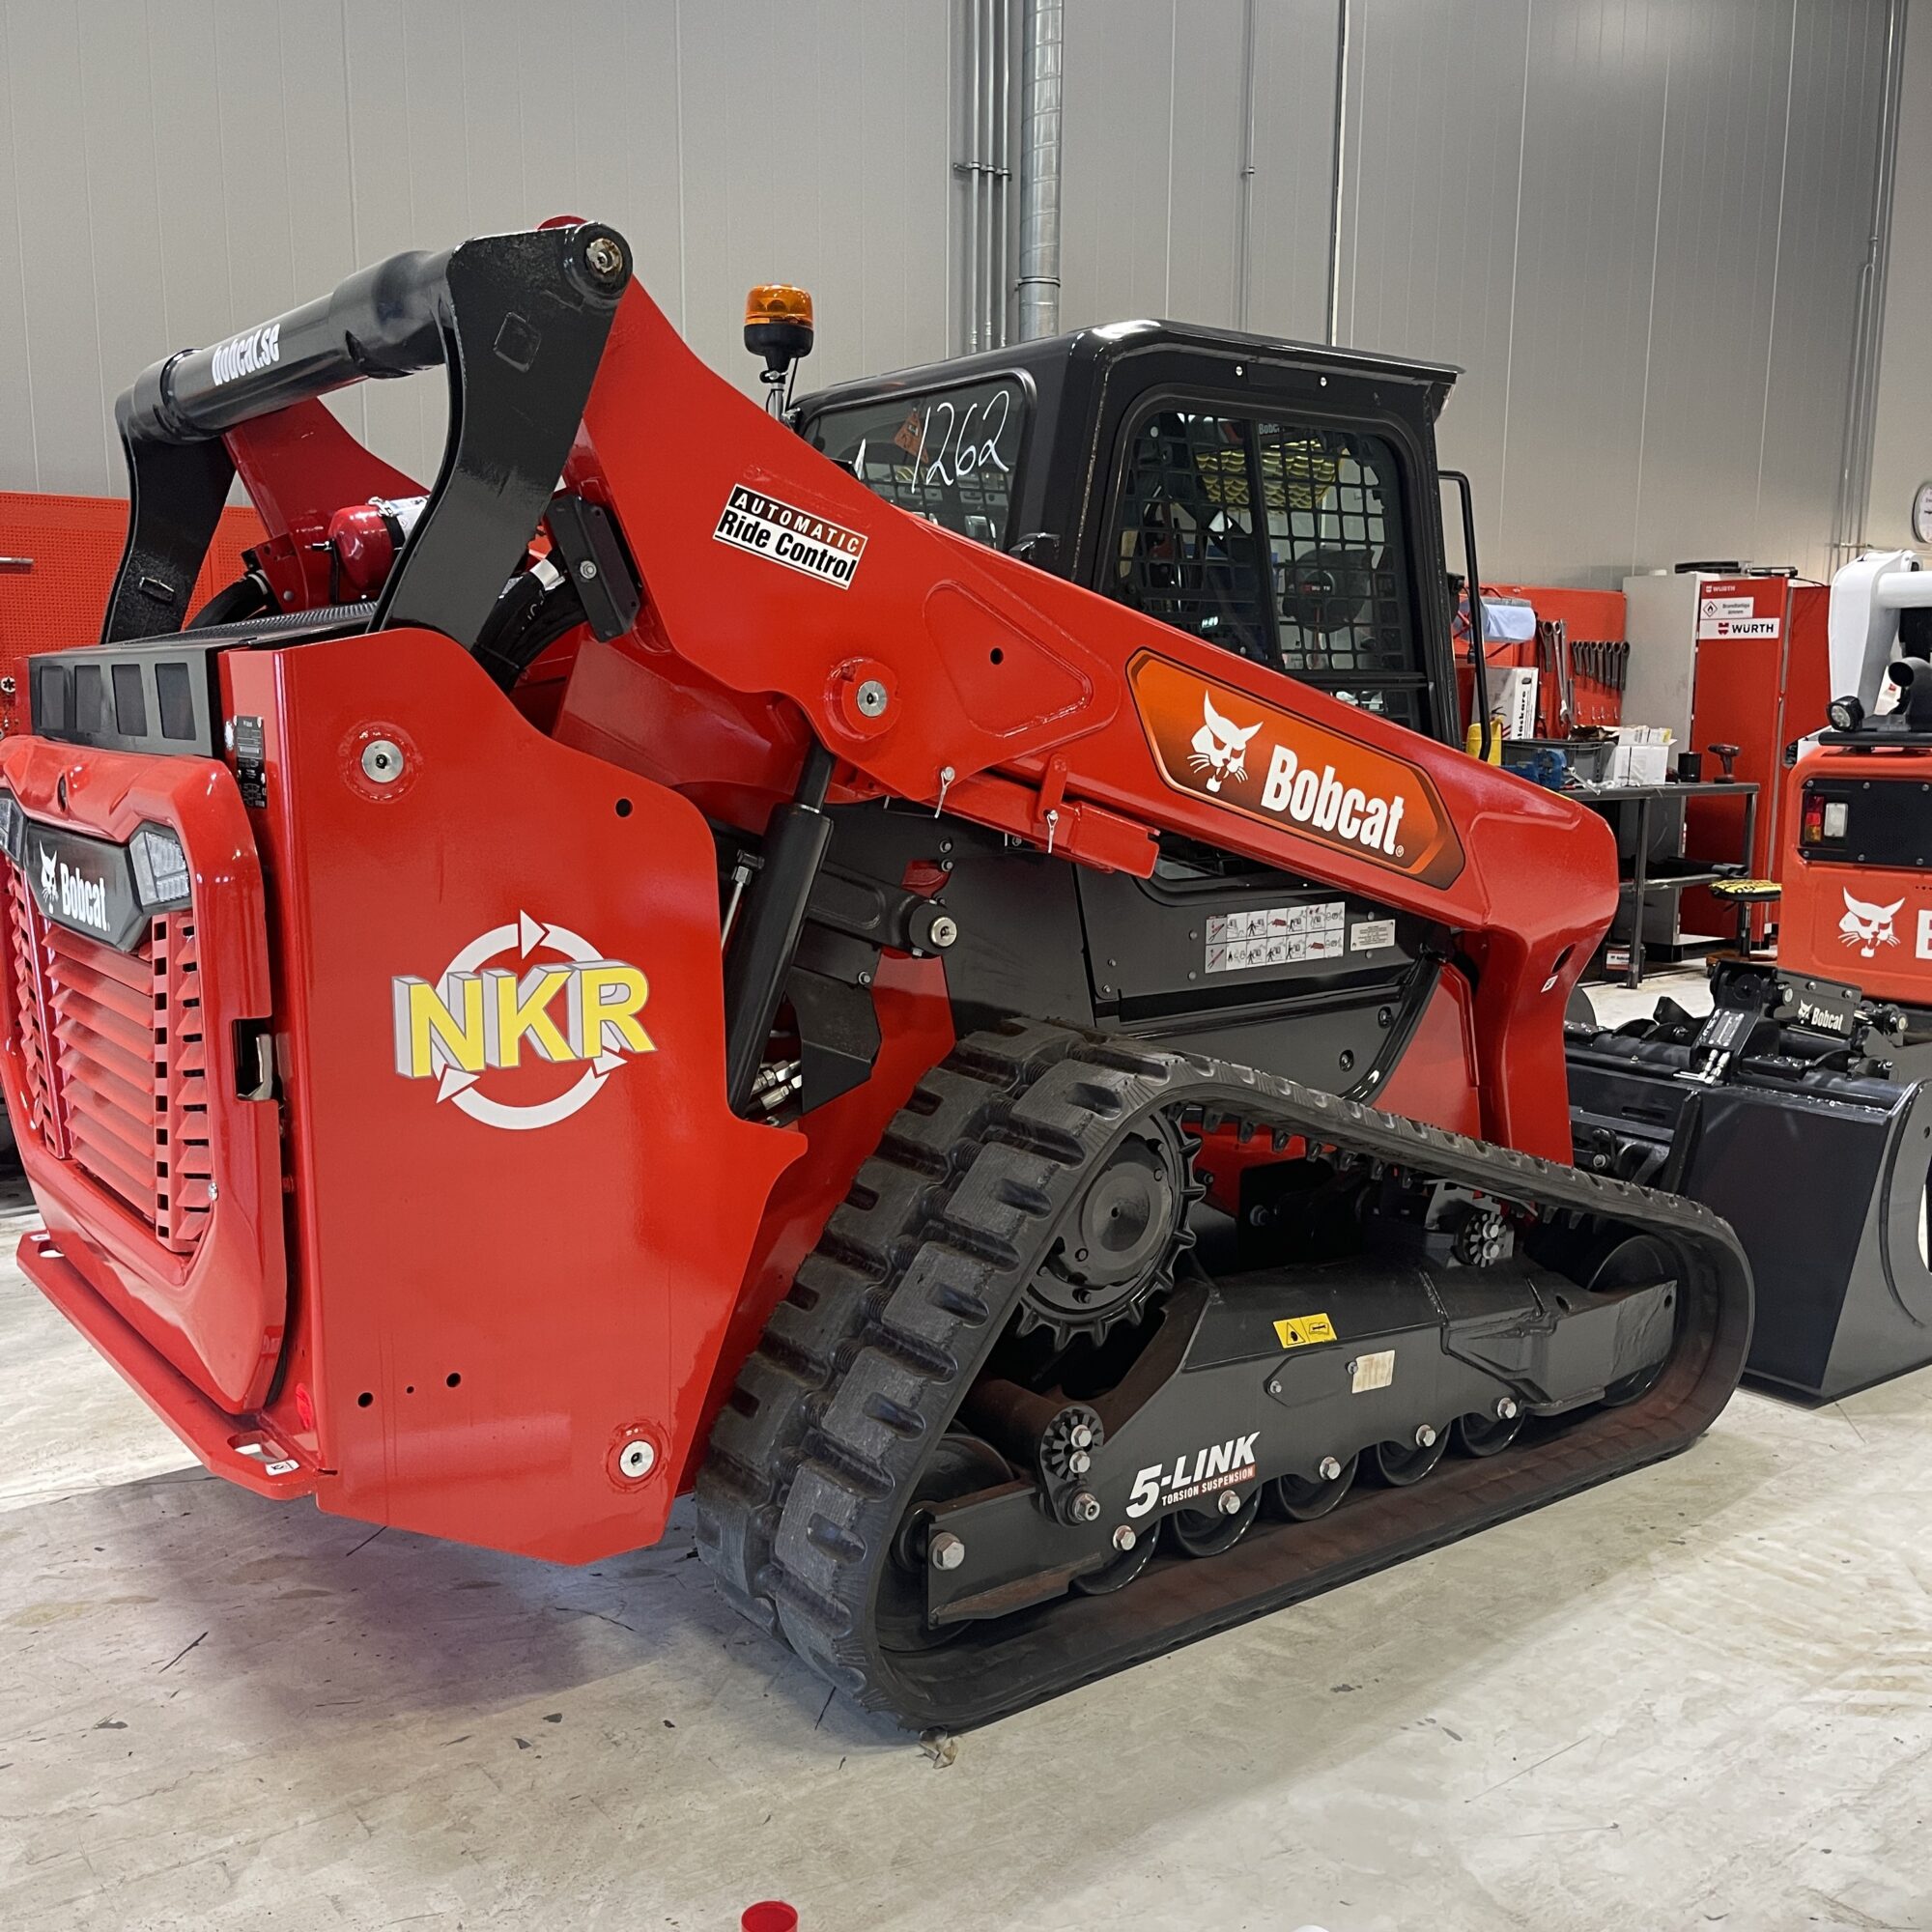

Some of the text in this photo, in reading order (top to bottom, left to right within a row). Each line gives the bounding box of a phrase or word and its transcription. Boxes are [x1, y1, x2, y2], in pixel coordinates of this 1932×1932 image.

[911, 389, 1010, 495] 1262
[717, 508, 858, 582] Ride Control
[734, 493, 860, 553] AUTOMATIC
[1732, 623, 1775, 634] WÜRTH
[1261, 744, 1405, 856] Bobcat
[60, 863, 107, 931] Bobcat
[391, 958, 658, 1080] NKR
[1810, 1007, 1844, 1032] Bobcat
[1125, 1431, 1261, 1519] 5-LINK
[1161, 1466, 1254, 1506] TORSION SUSPENSION
